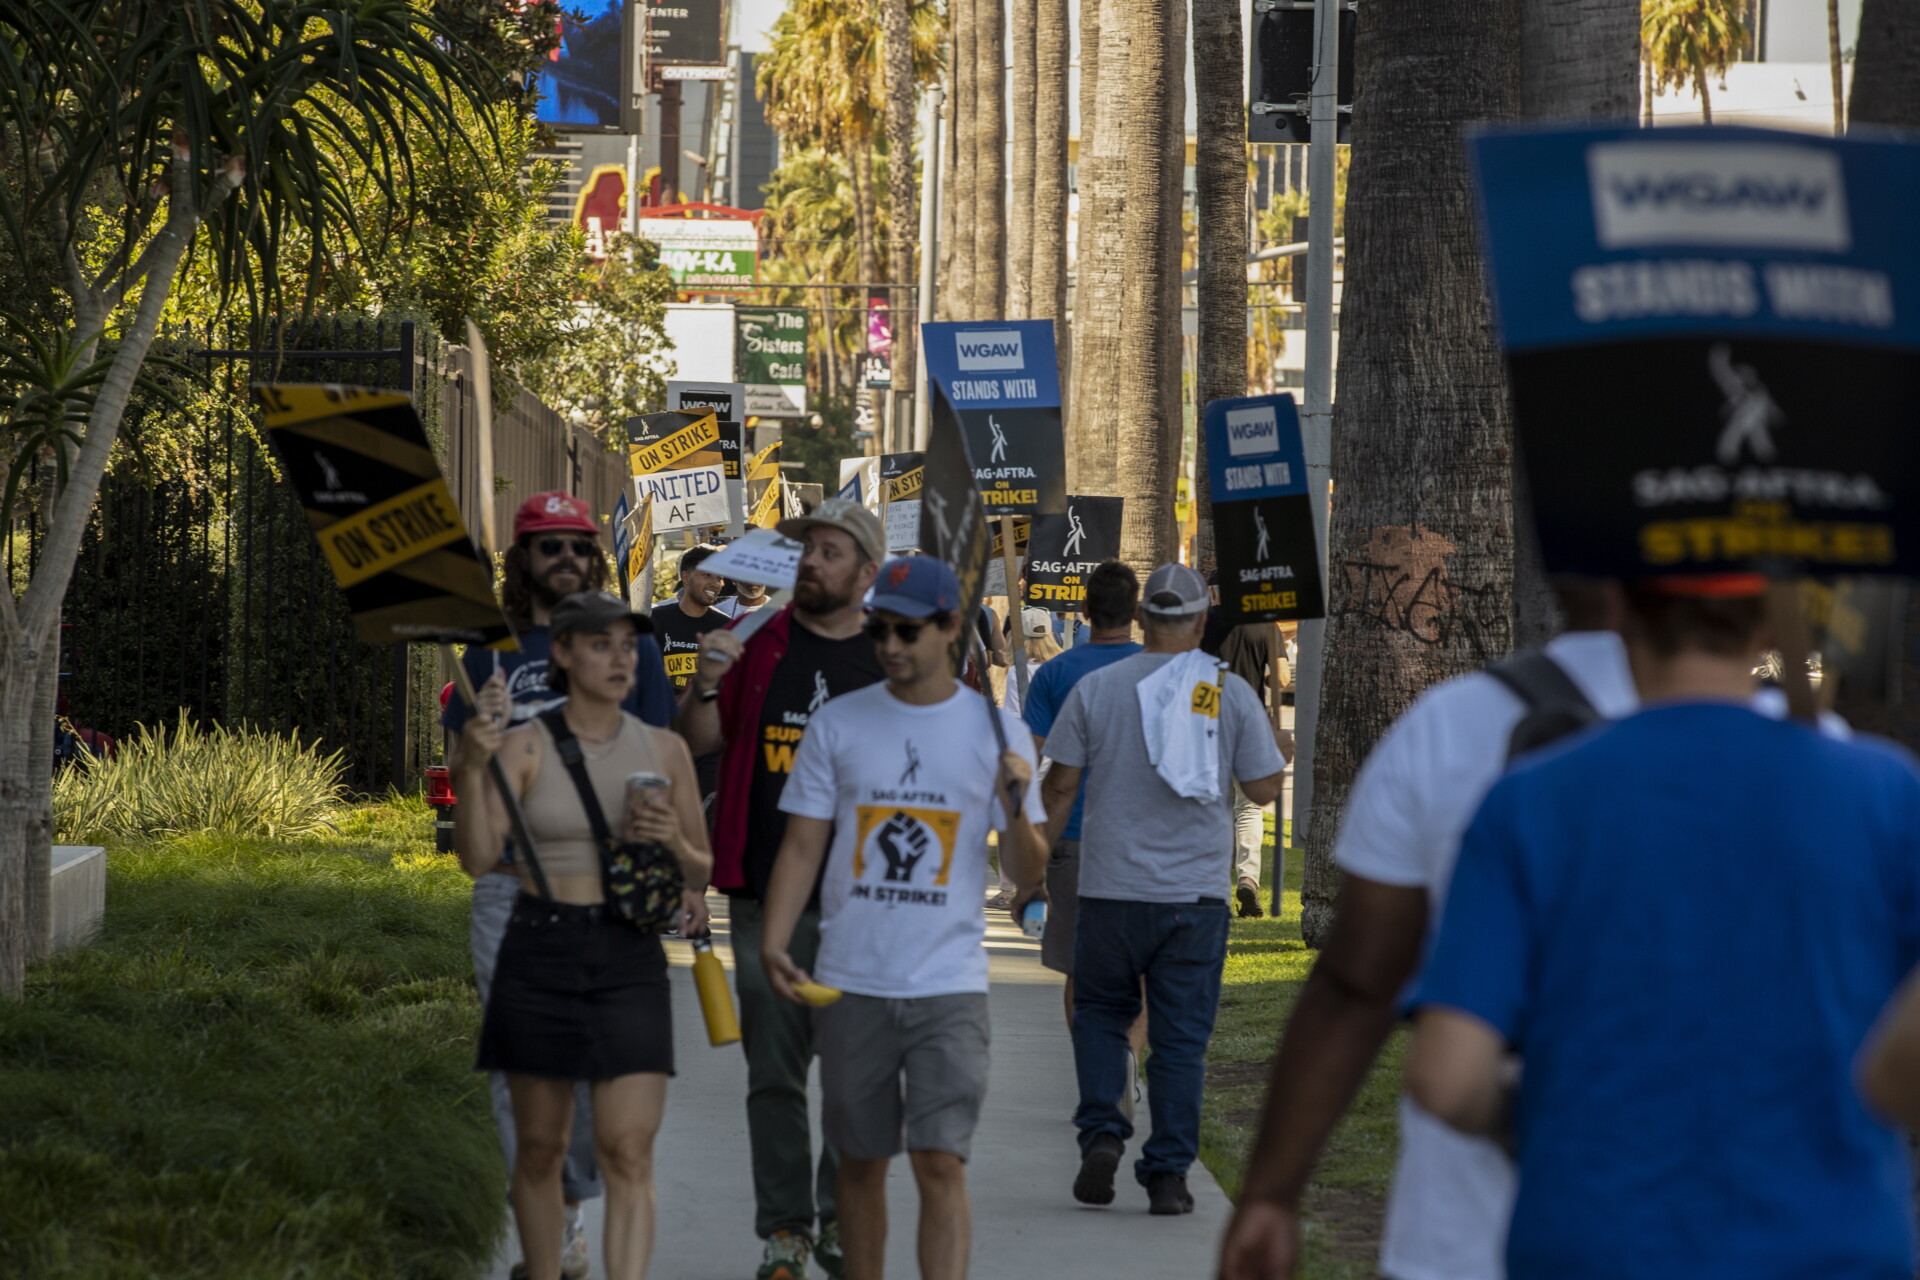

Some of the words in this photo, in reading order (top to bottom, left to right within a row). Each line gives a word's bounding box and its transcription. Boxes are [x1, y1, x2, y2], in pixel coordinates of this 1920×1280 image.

[1610, 174, 1830, 214] WGAW
[1571, 260, 1758, 322] STANDS
[1764, 263, 1895, 327] WITH
[777, 312, 805, 329] The
[740, 322, 804, 354] Sisters
[959, 342, 1019, 359] WGAW
[769, 362, 803, 380] Café
[951, 380, 1000, 401] STANDS
[1003, 378, 1038, 399] WITH
[1230, 420, 1275, 441] WGAW
[639, 453, 662, 470] ON
[660, 422, 713, 460] STRIKE
[638, 470, 720, 503] UNITED
[994, 480, 1010, 489] ON
[1226, 467, 1262, 491] STANDS
[1262, 462, 1292, 487] WITH
[980, 490, 1038, 504] TRIKE!
[669, 503, 696, 523] AF
[332, 531, 380, 570] ON
[366, 492, 457, 554] STRIKE
[1063, 576, 1081, 585] ON
[1260, 583, 1273, 592] ON
[1029, 584, 1088, 600] STRIK
[1241, 590, 1297, 612] STRIKE!
[668, 659, 682, 672] ON
[676, 676, 687, 686] ON
[875, 887, 948, 907] STRIKE!
